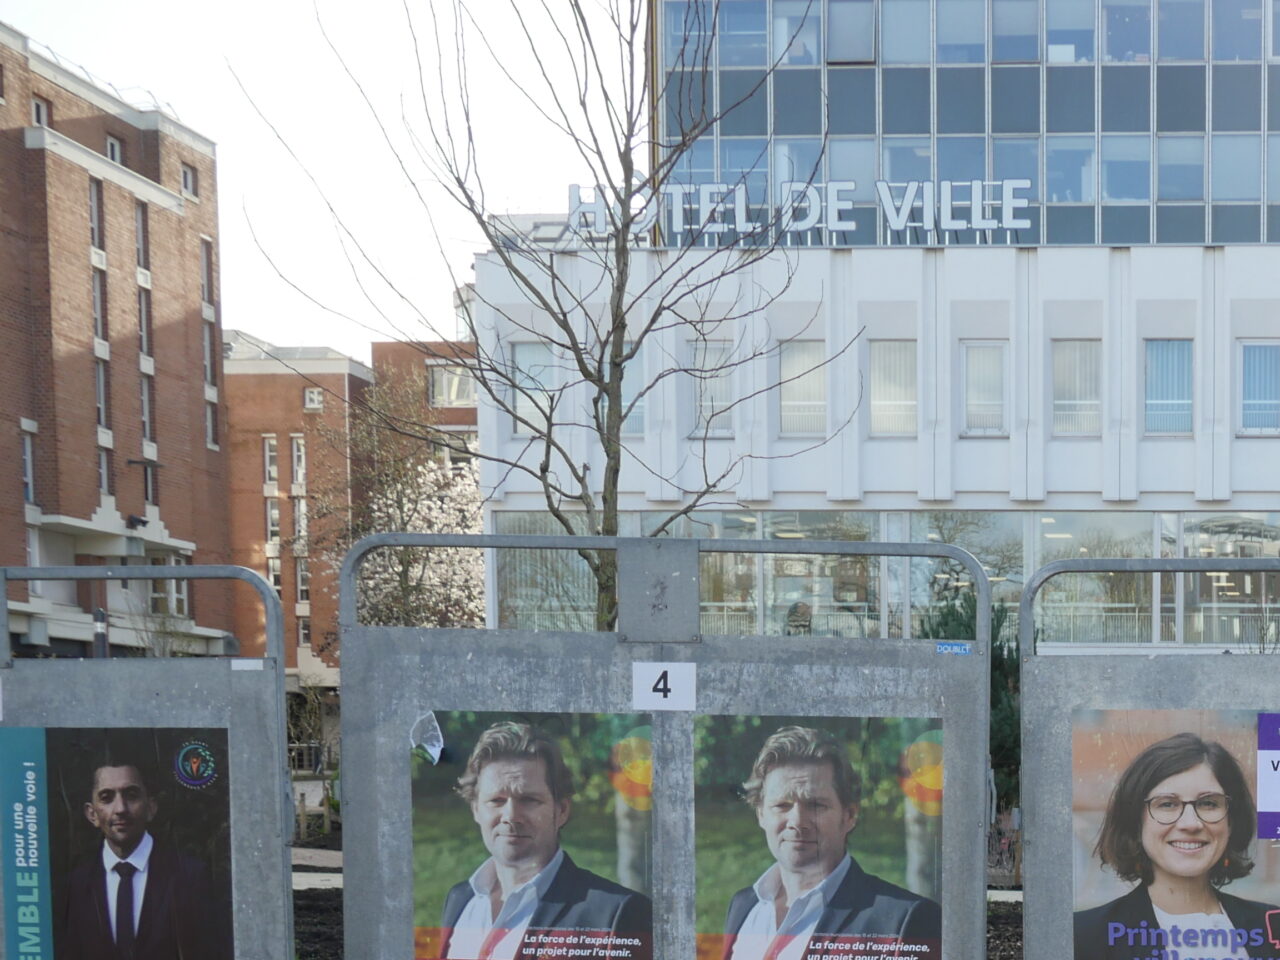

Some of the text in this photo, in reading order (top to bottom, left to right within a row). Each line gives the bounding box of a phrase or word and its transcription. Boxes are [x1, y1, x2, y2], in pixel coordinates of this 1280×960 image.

[781, 180, 857, 232] DE
[875, 178, 1032, 231] VILLE
[651, 669, 672, 699] 4
[25, 770, 37, 801] voie
[13, 802, 28, 867] pour une
[25, 806, 38, 867] nouvelle
[522, 946, 632, 958] un projet pour l'avenir.
[524, 934, 642, 947] La force de l'expérience,
[809, 940, 930, 953] La force de l'expérience,
[1107, 920, 1265, 953] Printemps
